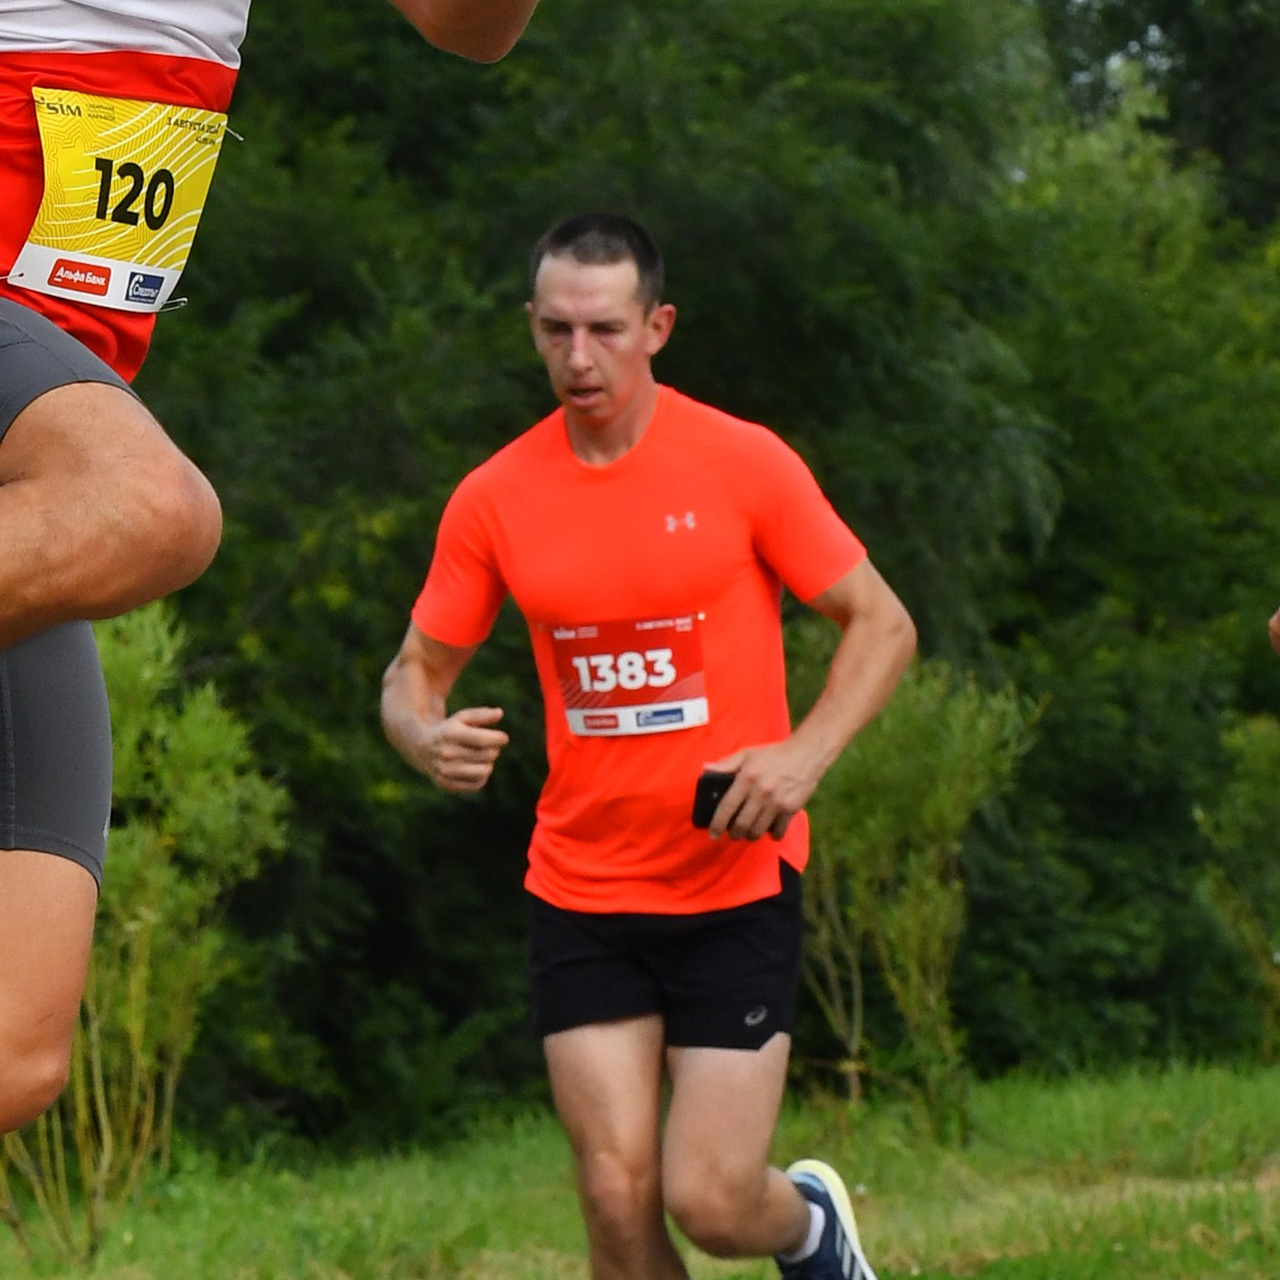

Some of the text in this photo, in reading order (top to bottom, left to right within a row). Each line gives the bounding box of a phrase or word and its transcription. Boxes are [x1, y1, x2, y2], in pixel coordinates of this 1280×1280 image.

[95, 157, 175, 231] 120
[54, 266, 106, 286] Альфа Банк
[572, 648, 676, 693] 1383
